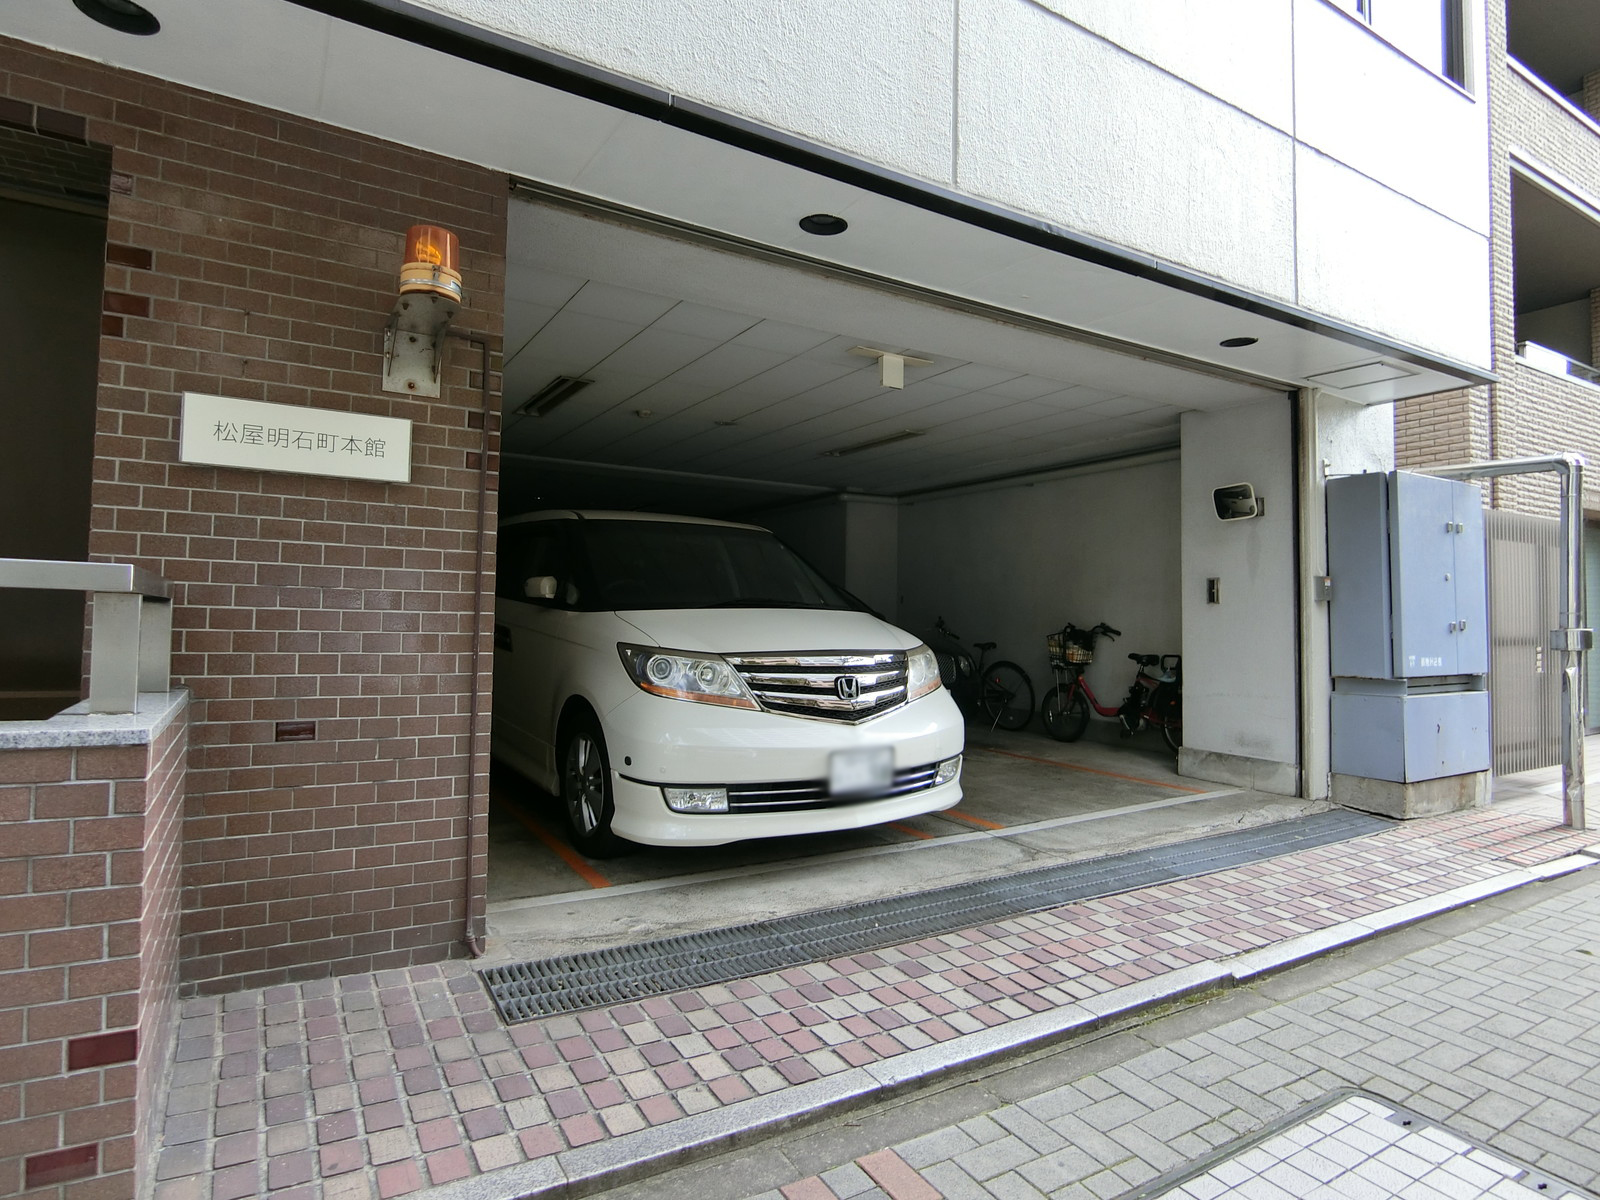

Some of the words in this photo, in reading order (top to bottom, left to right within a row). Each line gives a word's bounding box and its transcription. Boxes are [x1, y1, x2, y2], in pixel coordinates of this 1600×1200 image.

[213, 420, 386, 458] 松屋明石町本館
